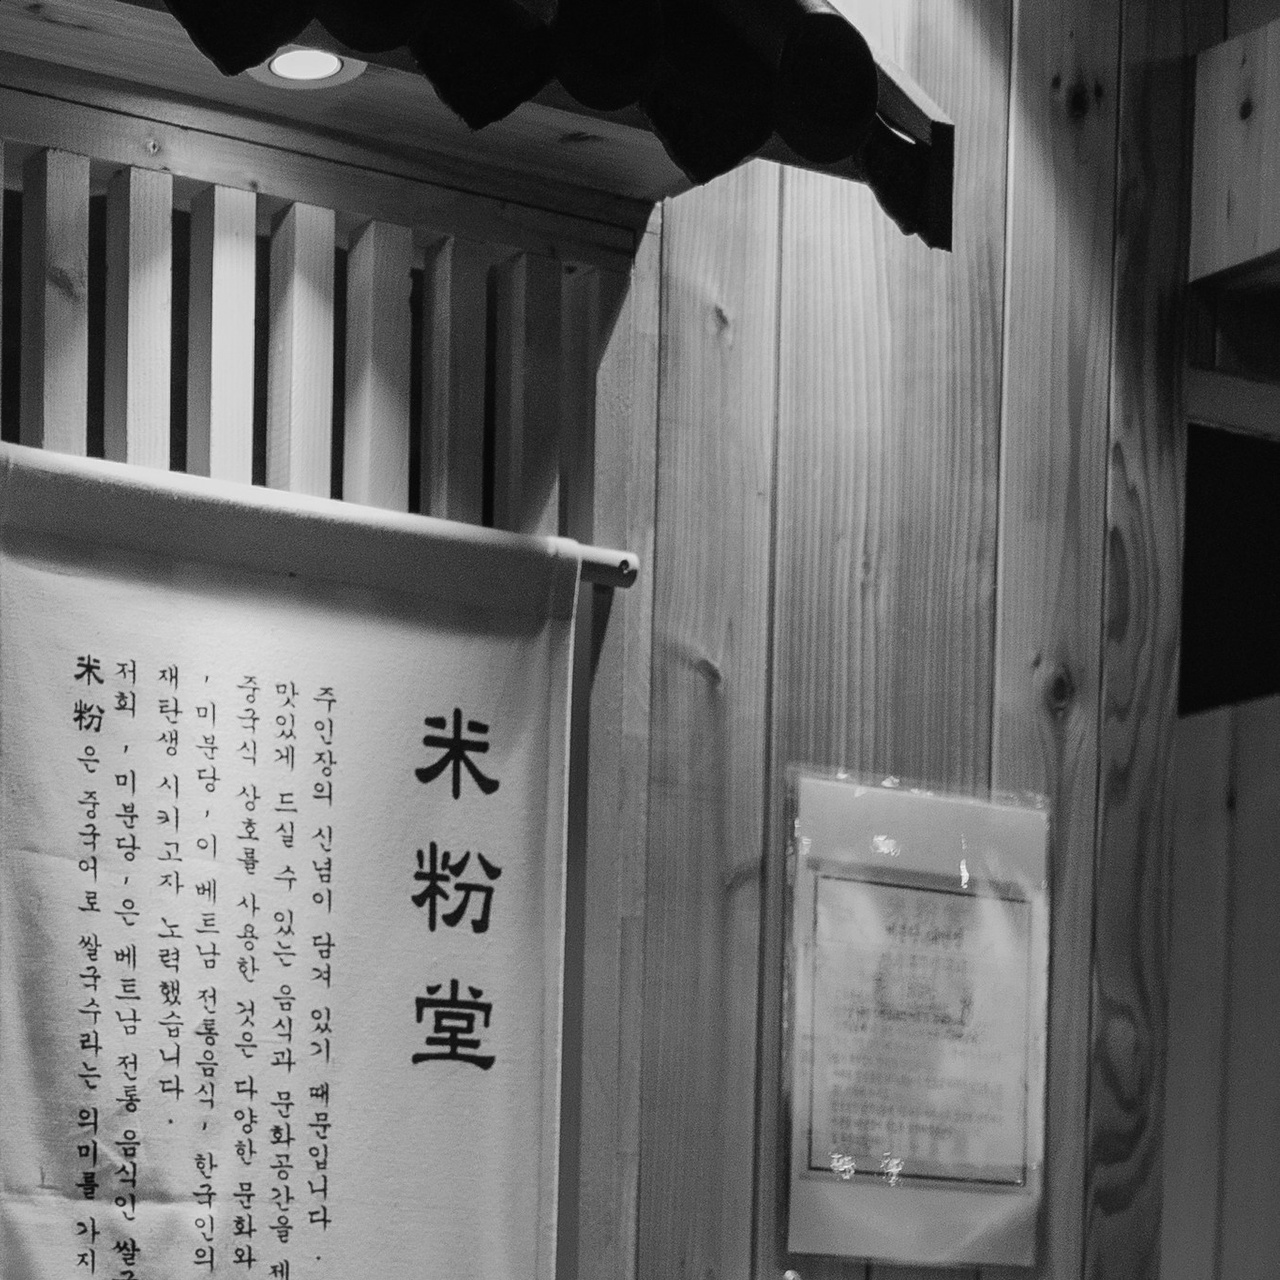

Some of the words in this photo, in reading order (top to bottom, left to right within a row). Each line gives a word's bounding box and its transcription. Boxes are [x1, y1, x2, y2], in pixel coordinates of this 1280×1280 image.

[115, 659, 136, 718] 저희
[157, 664, 183, 756] 재탄생
[237, 676, 260, 766] 중국식
[275, 681, 299, 771] 맛있게
[313, 687, 337, 807] 주인장의
[78, 791, 101, 912] 중국어로
[157, 774, 184, 895] 시키고자
[237, 784, 261, 875] 상호를
[274, 793, 298, 848] 드실
[274, 865, 297, 891] 수
[312, 825, 332, 913] 신념이
[412, 708, 503, 1070] 米粉堂
[195, 879, 221, 969] 베트남
[236, 892, 260, 983] 사용한
[273, 909, 297, 967] 있는
[312, 932, 336, 988] 담겨
[78, 933, 102, 1090] 쌀국수라는
[114, 944, 141, 1035] 베트남
[235, 1000, 258, 1058] 것은
[271, 985, 296, 1073] 음식과
[311, 1007, 332, 1064] 있기
[116, 1053, 141, 1115] 전통
[234, 1075, 258, 1166] 다양한
[75, 1107, 98, 1200] 의미를
[114, 1130, 141, 1221] 음식인
[269, 1091, 295, 1243] 문화공간을
[192, 1152, 218, 1274] 한국인의
[233, 1182, 257, 1270] 문화와
